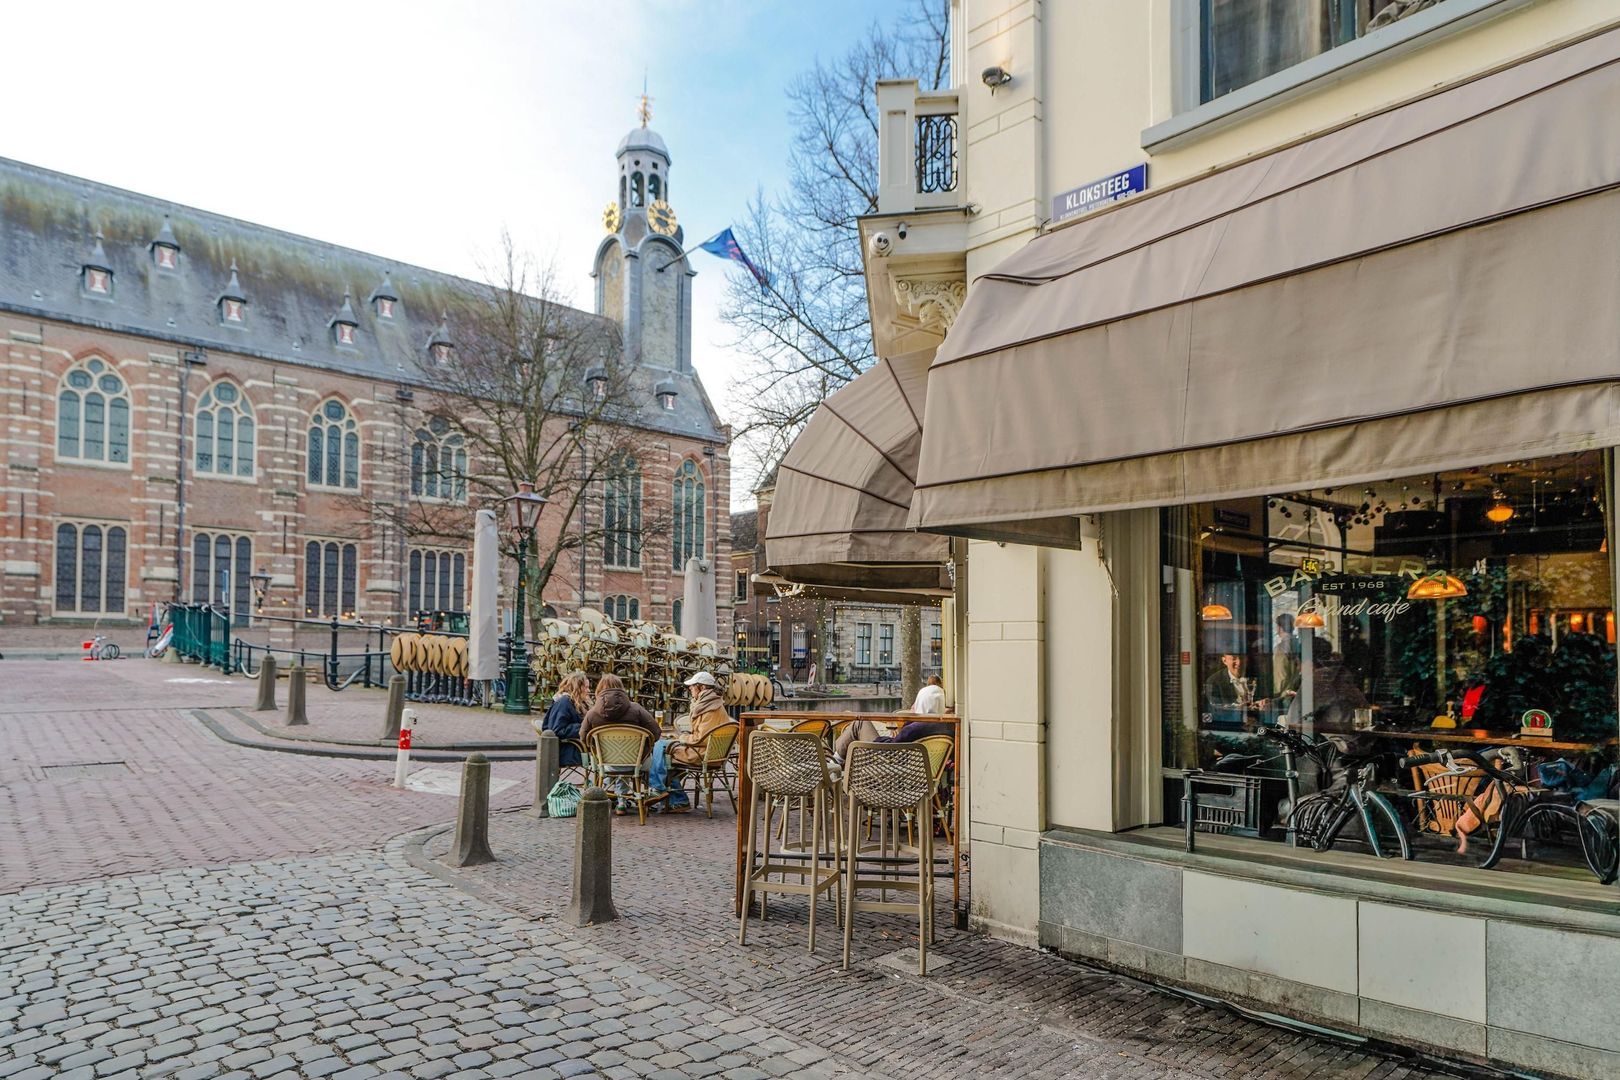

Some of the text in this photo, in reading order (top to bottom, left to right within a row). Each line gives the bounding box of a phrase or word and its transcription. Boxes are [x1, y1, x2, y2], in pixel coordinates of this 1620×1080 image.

[1066, 173, 1130, 210] KLOKSTEEG
[1263, 557, 1448, 599] BARRERA
[1322, 580, 1385, 591] EST 1968
[1366, 596, 1411, 623] cafe
